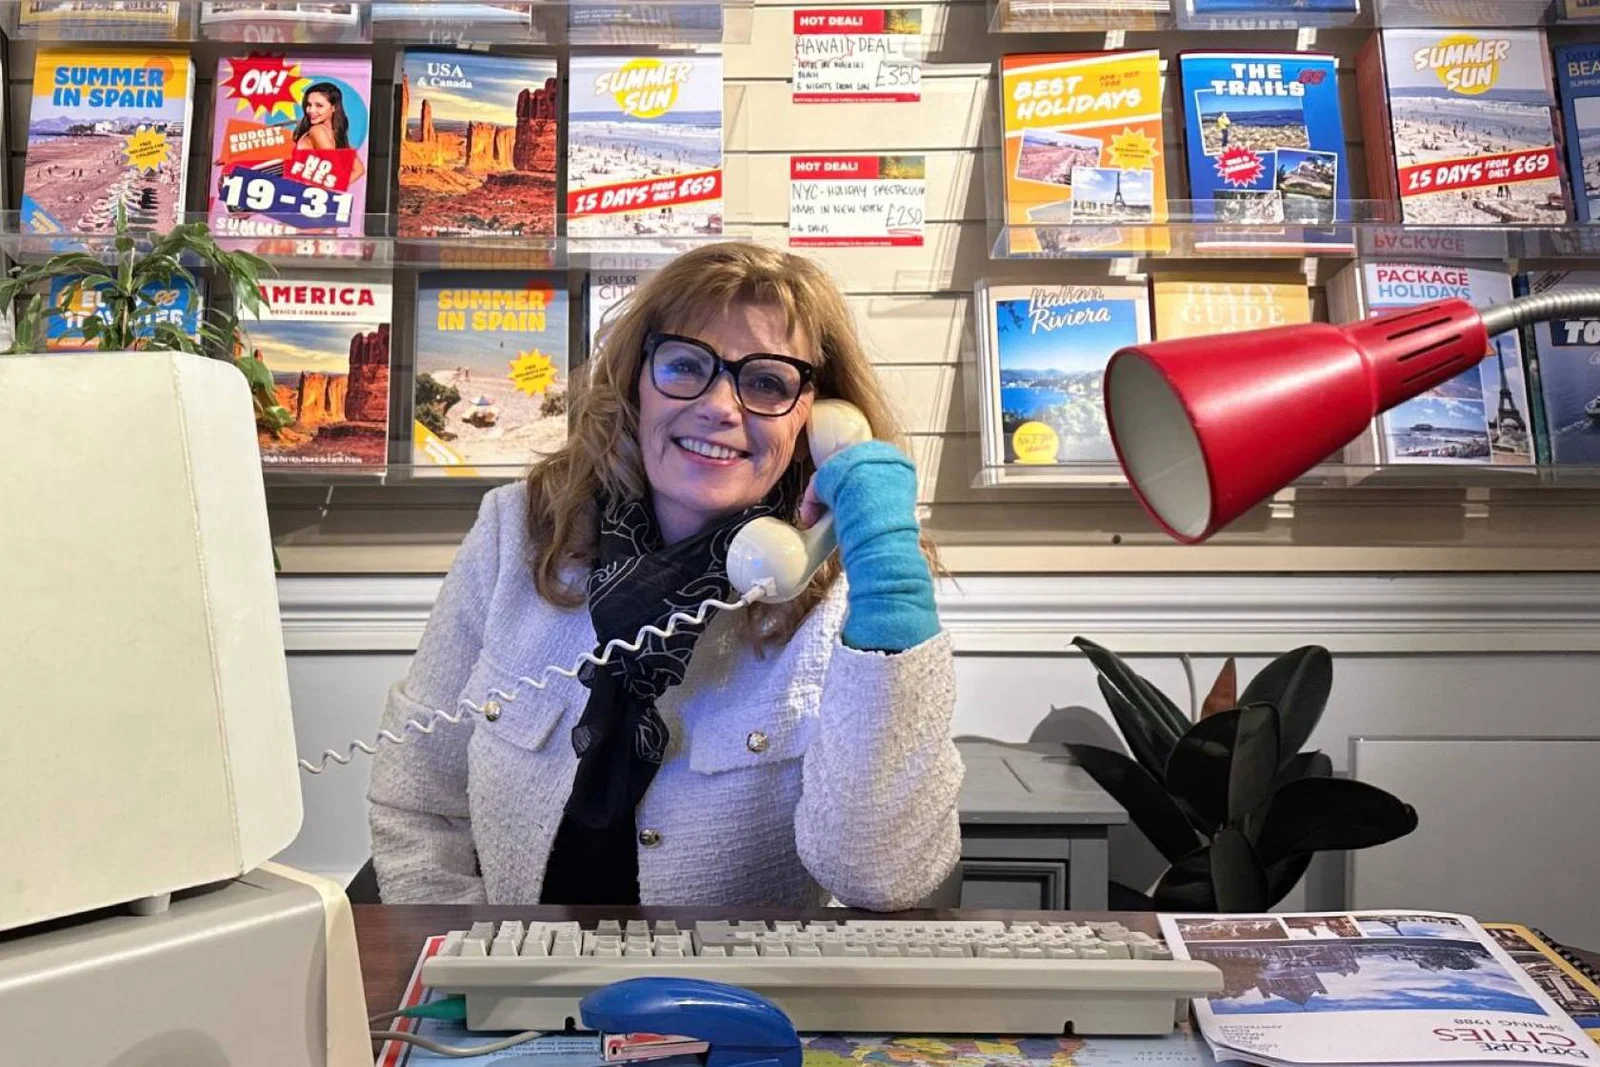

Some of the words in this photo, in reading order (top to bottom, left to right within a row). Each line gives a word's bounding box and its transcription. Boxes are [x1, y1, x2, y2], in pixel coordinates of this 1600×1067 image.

[800, 16, 825, 26] HOT
[828, 16, 863, 26] DEAL!
[858, 37, 898, 53] DEAL
[1413, 39, 1511, 71] SUMMER
[54, 66, 164, 87] SUMMER
[427, 63, 464, 78] USA
[595, 61, 694, 95] SUMMER
[1231, 63, 1283, 79] THE
[1446, 65, 1492, 92] SUN
[240, 69, 287, 97] OK!
[417, 77, 429, 87] &
[430, 77, 473, 89] Canada
[1013, 76, 1083, 101] BEST
[1211, 80, 1305, 96] TRAILS
[52, 88, 81, 107] IN
[88, 88, 164, 108] SPAIN
[624, 89, 672, 115] SUN
[1016, 87, 1143, 121] HOLIDAYS
[230, 126, 283, 143] BUDGET
[230, 135, 285, 153] EDITION
[307, 154, 332, 174] NO
[795, 161, 821, 172] HOT
[824, 161, 859, 172] DEAL!
[1408, 168, 1432, 190] 15
[1435, 162, 1483, 184] DAYS
[1513, 154, 1550, 175] £69
[1485, 158, 1510, 169] FROM
[1488, 168, 1510, 179] ONLY
[291, 161, 337, 188] FEES
[575, 192, 599, 213] 15
[600, 185, 649, 209] DAYS
[679, 176, 716, 197] £69
[833, 204, 856, 214] NEW
[1376, 269, 1469, 286] PACKAGE
[258, 285, 375, 306] AMERICA
[438, 289, 546, 311] SUMMER
[1029, 285, 1105, 312] Italian
[1185, 284, 1278, 304] ITALY
[1378, 284, 1472, 300] HOLIDAYS
[438, 311, 466, 331] IN
[471, 311, 546, 332] SPAIN
[1028, 307, 1112, 335] Riviera
[1181, 304, 1286, 326] GUIDE
[1498, 1020, 1565, 1032] SPRING
[1433, 1028, 1577, 1048] CITIES
[1476, 1042, 1590, 1059] EXPLORE
